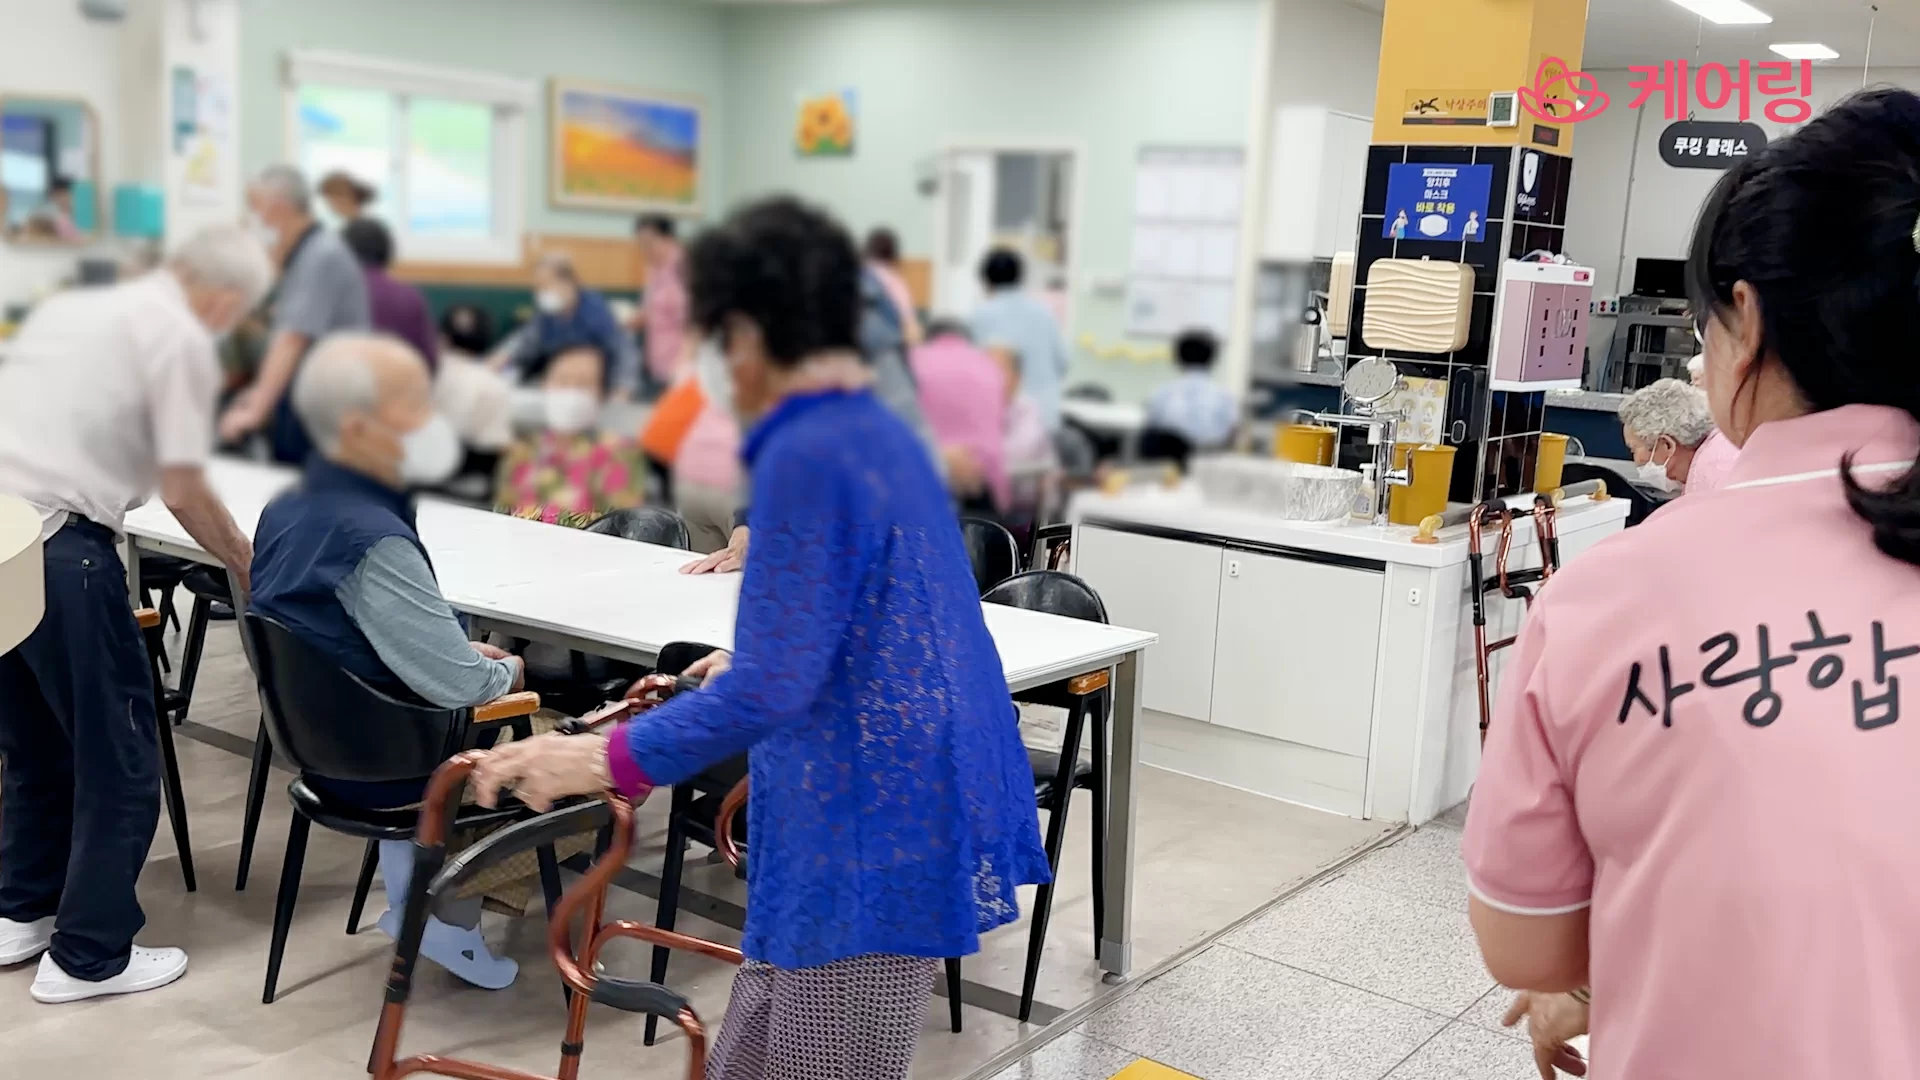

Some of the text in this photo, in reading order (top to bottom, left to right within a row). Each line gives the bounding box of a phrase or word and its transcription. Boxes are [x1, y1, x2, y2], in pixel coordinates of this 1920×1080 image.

[1674, 137, 1748, 157] 쿠킹 클래스
[1424, 189, 1449, 200] 마스크
[1415, 202, 1456, 215] 바로 착용
[1617, 610, 1920, 730] 사랑합
